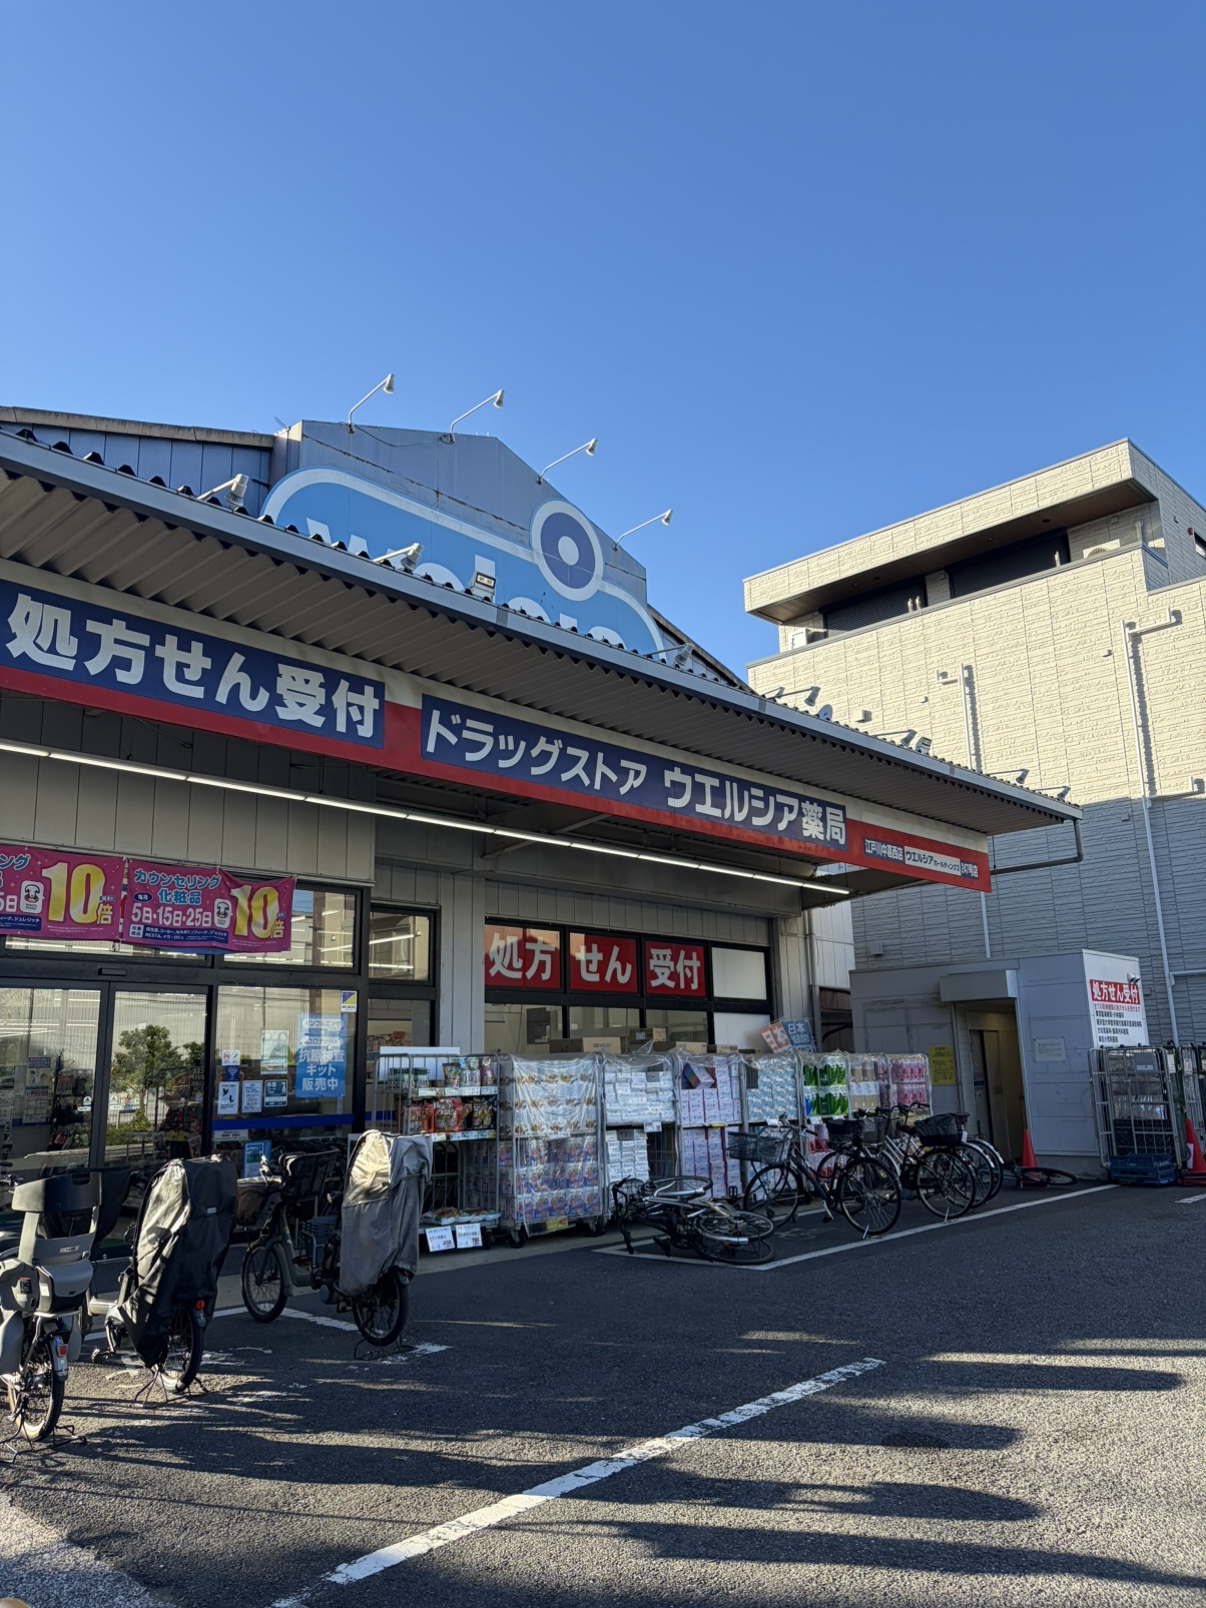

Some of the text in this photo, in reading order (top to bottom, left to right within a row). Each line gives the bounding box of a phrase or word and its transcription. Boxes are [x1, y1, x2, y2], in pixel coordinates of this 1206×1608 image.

[5, 593, 380, 738] 処方せん受付
[426, 709, 847, 846] ドラッグストア ウエルシア薬局
[134, 868, 222, 890] カウンセリング
[157, 888, 202, 905] 化粧品
[489, 932, 701, 990] 処方 せん 受付
[1092, 981, 1139, 1004] 処方せん受付
[787, 1022, 806, 1035] 日本
[298, 1048, 345, 1063] 抗原検査
[306, 1063, 336, 1076] キット
[302, 1077, 339, 1091] 販売中
